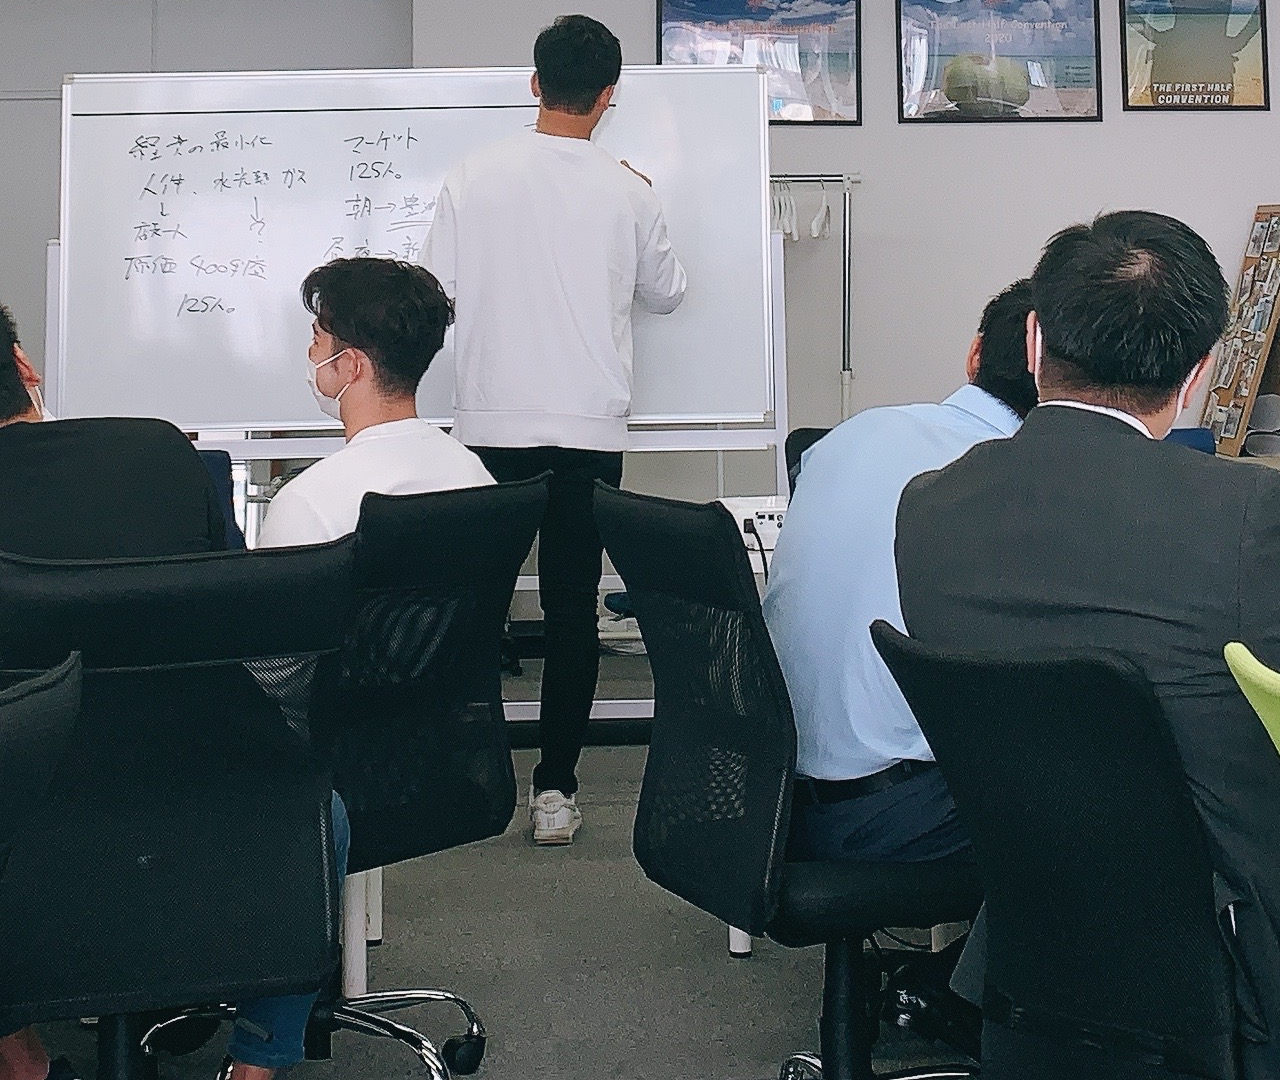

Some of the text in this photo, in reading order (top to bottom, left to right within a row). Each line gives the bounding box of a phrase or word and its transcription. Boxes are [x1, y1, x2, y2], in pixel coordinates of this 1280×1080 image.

[1153, 83, 1233, 92] THE FIRST HALF
[1158, 94, 1230, 105] CONVENTION
[343, 127, 419, 154] マーケット
[344, 193, 372, 220] 朝
